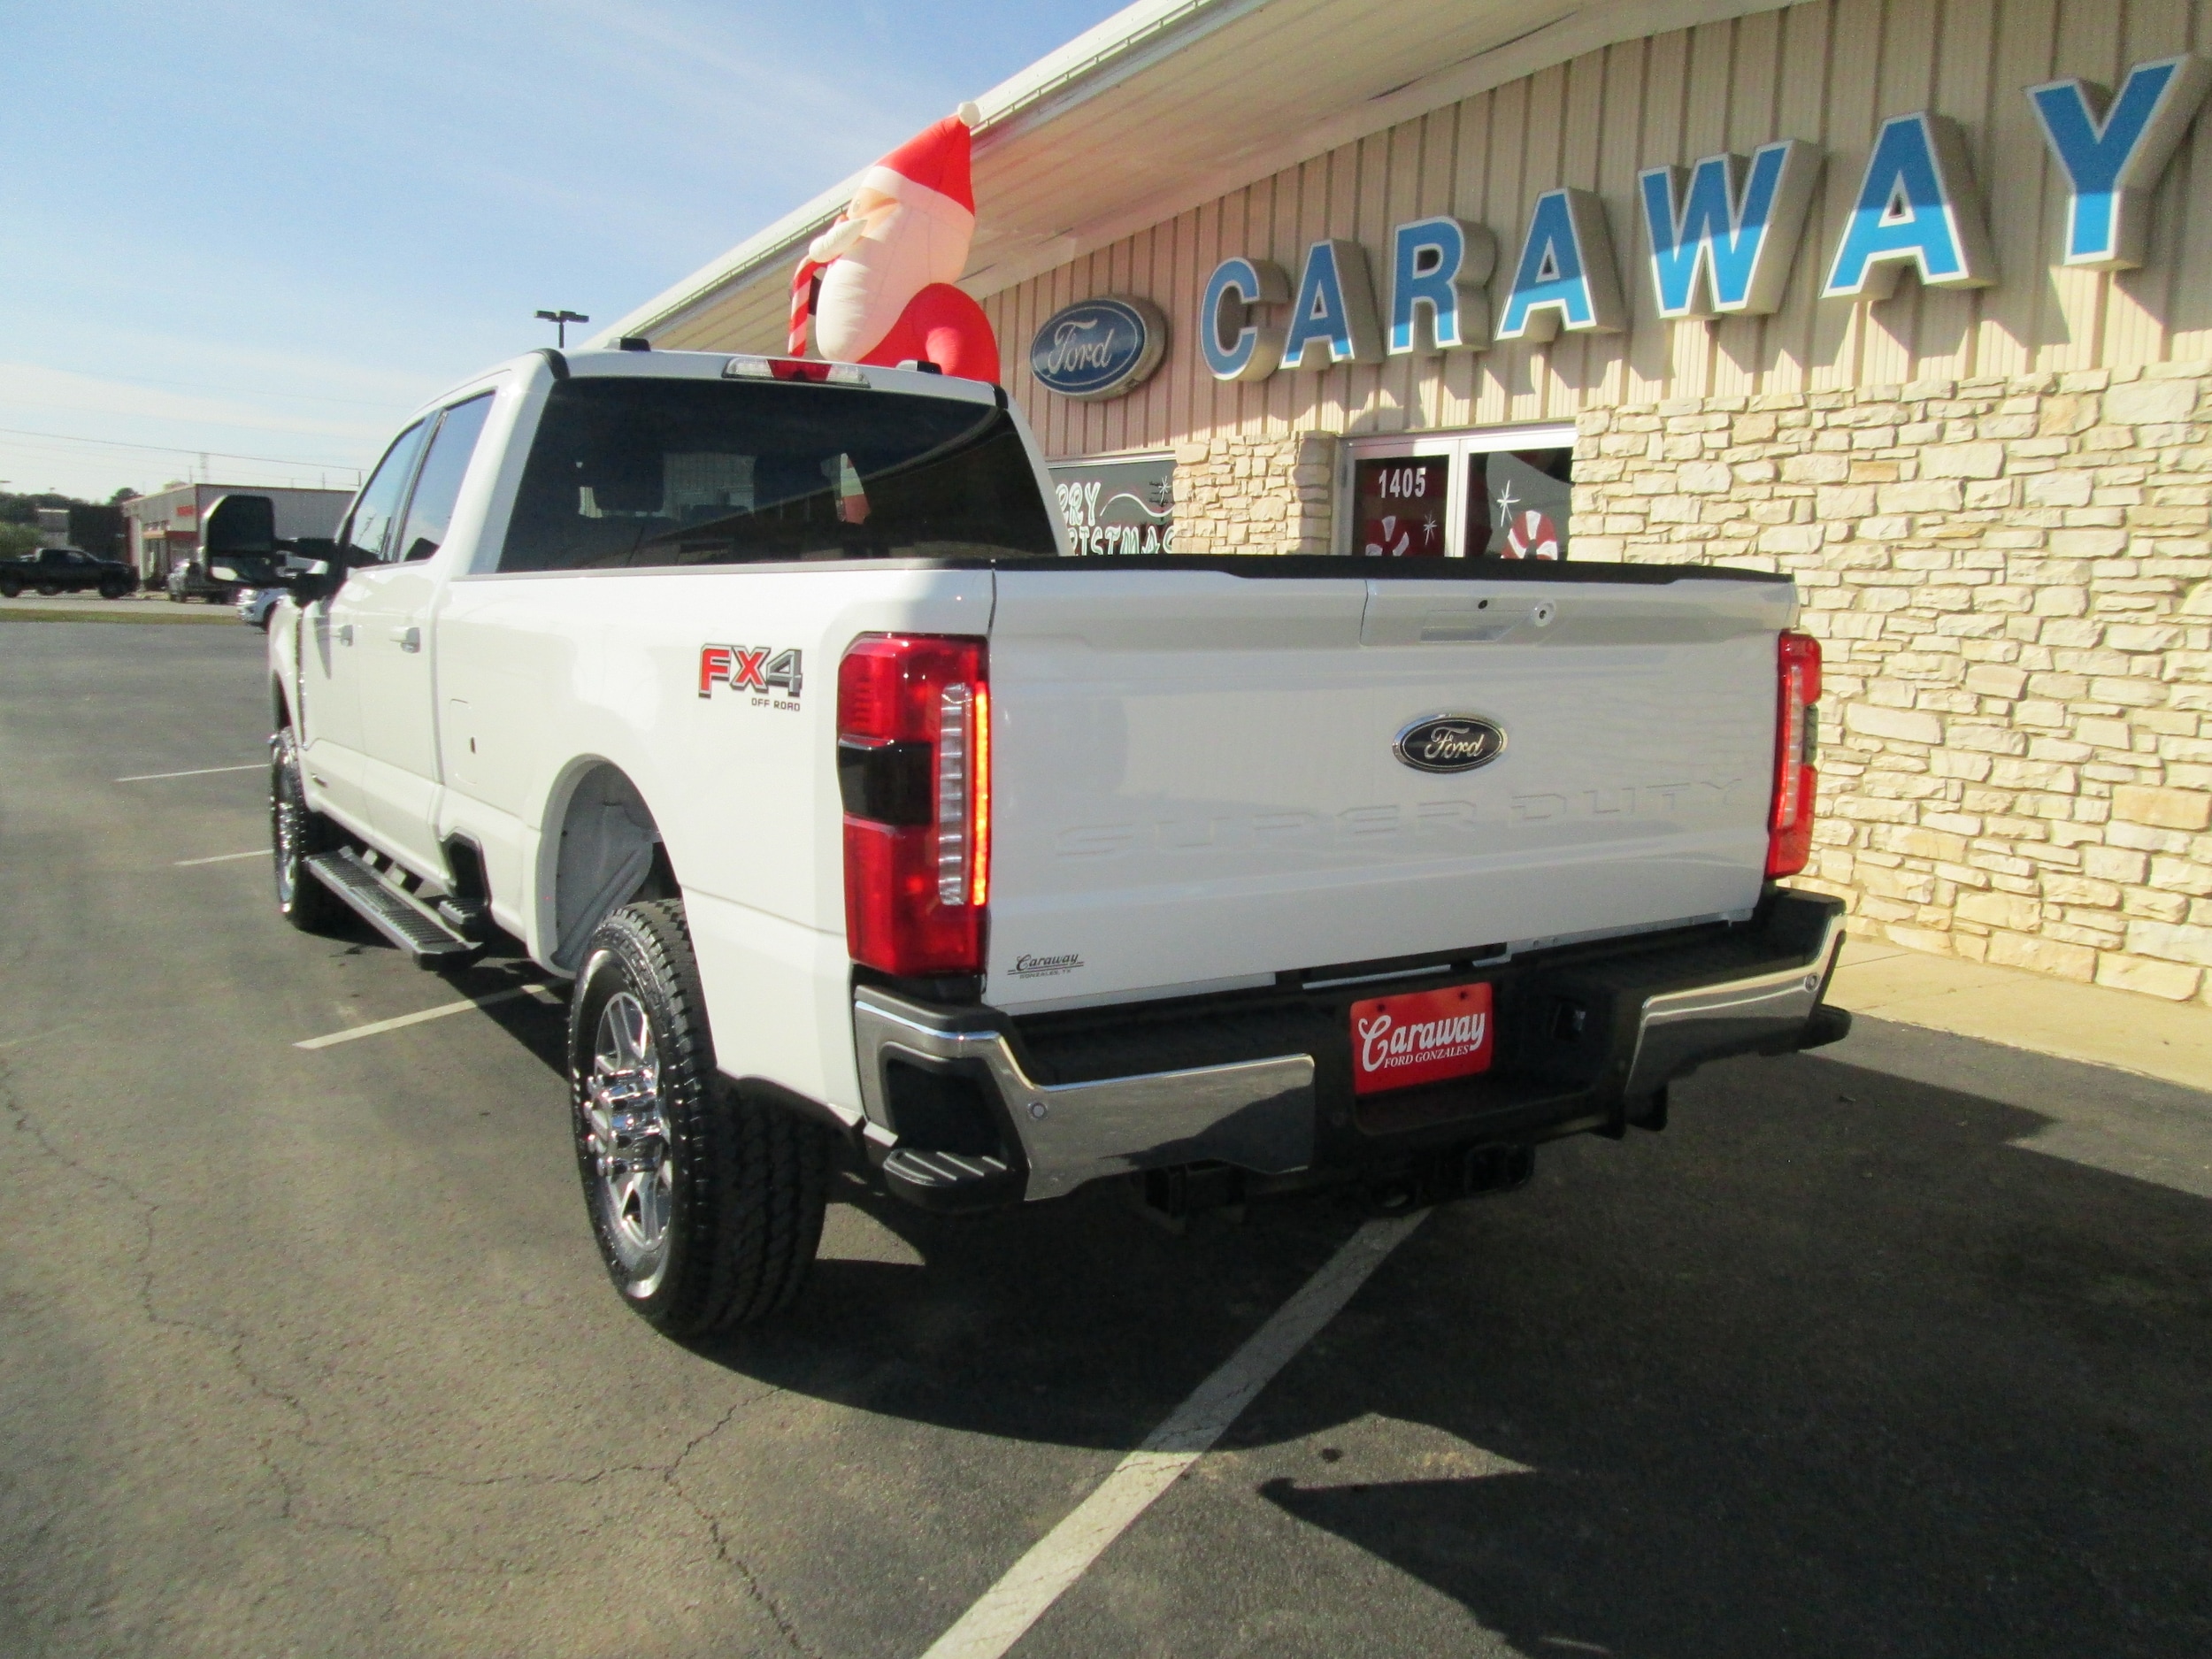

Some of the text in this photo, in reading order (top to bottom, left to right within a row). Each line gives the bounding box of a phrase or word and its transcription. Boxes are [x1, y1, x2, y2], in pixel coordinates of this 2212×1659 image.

[1200, 53, 2190, 380] CARAWAY
[1048, 319, 1115, 374] Ford
[1056, 481, 1102, 526] RRY
[1379, 466, 1426, 498] 1405
[698, 643, 803, 699] FX4
[751, 697, 801, 712] OFF ROAD
[1424, 726, 1486, 759] Ford
[1056, 778, 1742, 857] SUPER DUTY
[1016, 954, 1079, 972] Caraway
[1358, 1013, 1486, 1072] Caraway
[1384, 1044, 1470, 1069] FORD GONZALES
